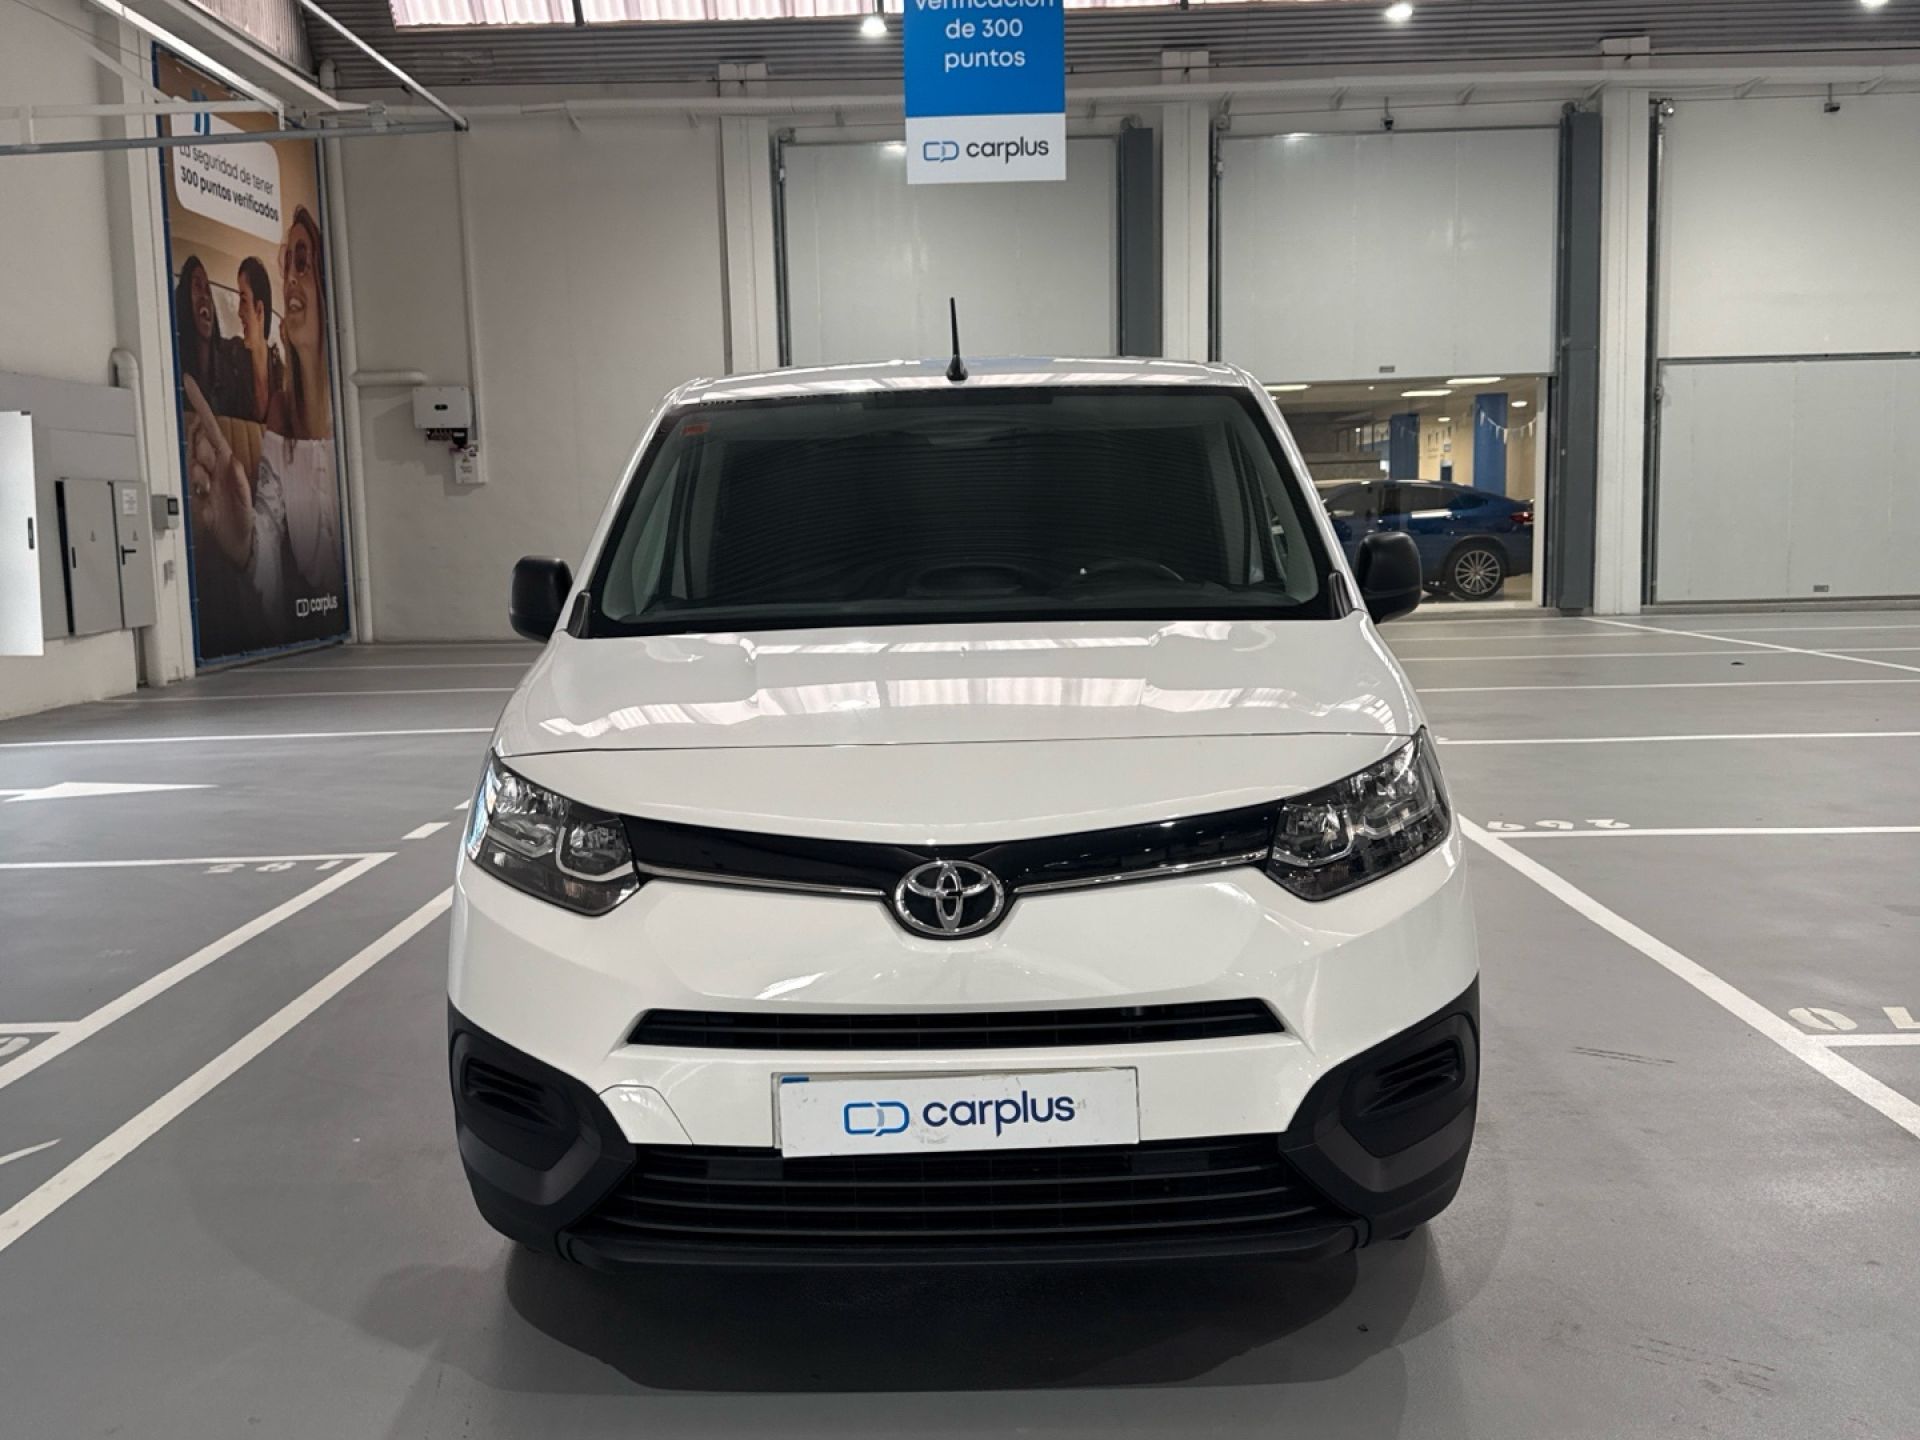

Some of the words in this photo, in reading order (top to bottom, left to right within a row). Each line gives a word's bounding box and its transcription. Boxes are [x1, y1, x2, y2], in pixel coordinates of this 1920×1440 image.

[945, 18, 976, 38] de
[981, 19, 1024, 38] 300
[944, 49, 1026, 72] puntos
[966, 136, 1049, 164] carplus
[193, 147, 238, 179] seguridad
[240, 168, 250, 186] de
[253, 174, 273, 195] tener
[181, 165, 198, 188] 300
[200, 178, 231, 202] puntos
[232, 190, 279, 222] verificados
[311, 593, 338, 616] carplus
[922, 1090, 1076, 1138] carplus
